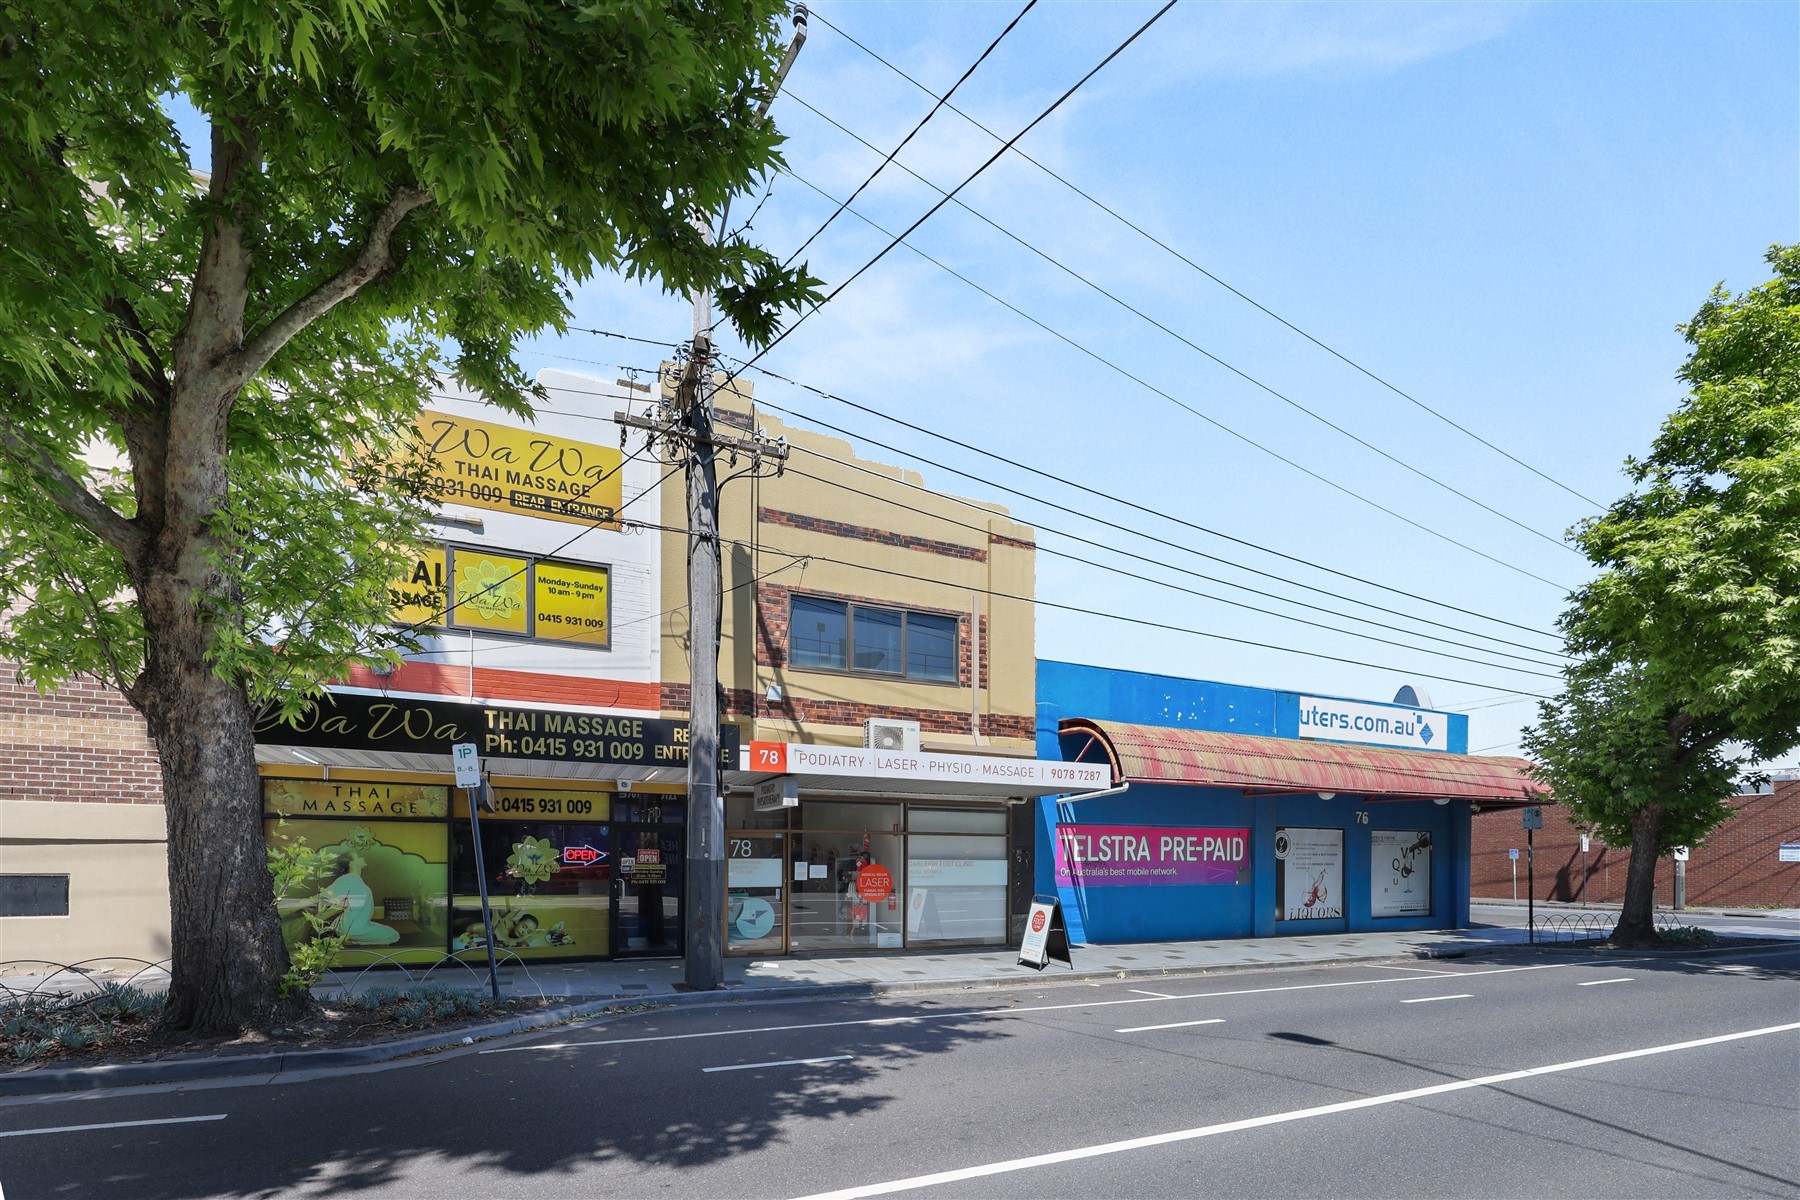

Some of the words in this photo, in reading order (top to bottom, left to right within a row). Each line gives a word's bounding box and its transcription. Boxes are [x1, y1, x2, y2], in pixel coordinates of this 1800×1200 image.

[432, 420, 520, 464] Wa
[529, 440, 606, 481] Wa
[455, 460, 499, 482] THAI
[506, 469, 591, 498] MASSAGE
[434, 476, 465, 498] 931
[470, 482, 503, 503] 009
[514, 493, 546, 510] REAR
[550, 499, 610, 519] ENTRANCE
[538, 576, 603, 593] Monday-Sunday
[548, 586, 557, 595] 10
[575, 590, 581, 598] 9
[581, 592, 595, 600] pm
[538, 612, 562, 624] 0415
[565, 616, 582, 626] 931
[585, 618, 604, 628] 009
[367, 703, 467, 741] Wa
[484, 709, 536, 731] THAI
[544, 714, 643, 738] MASSAGE
[458, 747, 472, 759] 1P
[485, 734, 518, 755] Ph:
[521, 736, 566, 755] 0415
[572, 740, 604, 758] 931
[609, 742, 644, 760] 009
[759, 750, 779, 765] 78
[799, 752, 865, 768] PODIATRY
[877, 757, 918, 771] LASER
[929, 760, 972, 775] PHYSIO
[982, 765, 1034, 778] MASSAGE
[1050, 768, 1075, 780] 9078
[1078, 770, 1101, 782] 7287
[333, 785, 391, 799] THAI
[302, 799, 417, 814] MASSAGE
[502, 797, 535, 812] 0415
[539, 799, 562, 813] 931
[566, 800, 592, 814] 009
[1355, 811, 1369, 825] 76
[565, 849, 598, 861] OPEN
[730, 839, 752, 858] 78
[1060, 835, 1151, 862] TELSTRA
[1160, 836, 1244, 862] PRE-PAID
[639, 854, 658, 863] OPEN
[940, 860, 954, 868] FOOT
[1060, 867, 1071, 877] On
[1072, 867, 1109, 877] Australia's
[1109, 867, 1126, 876] best
[1126, 867, 1150, 876] mobile
[1150, 867, 1179, 876] network.
[860, 877, 889, 888] LASER
